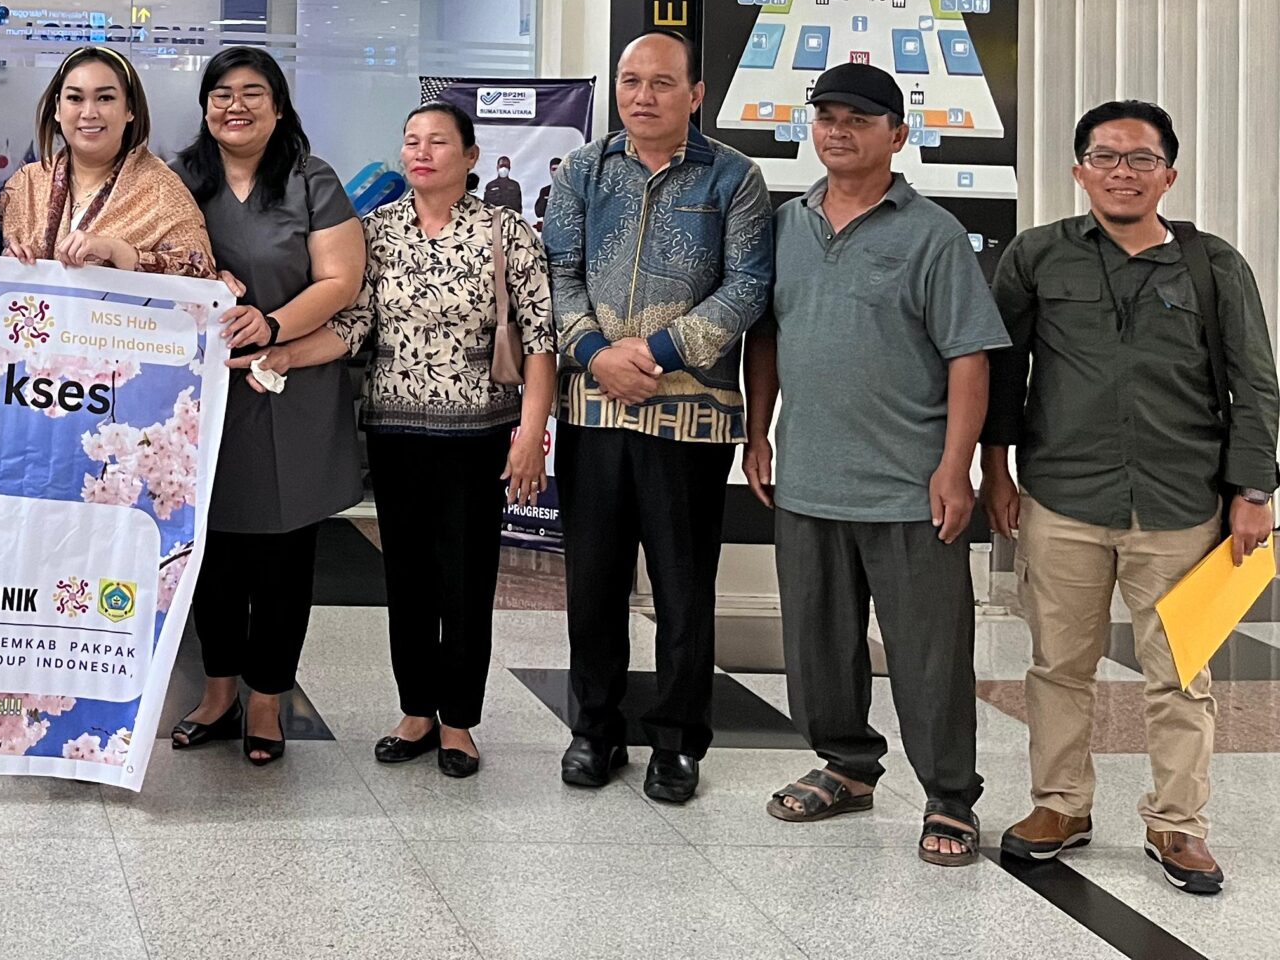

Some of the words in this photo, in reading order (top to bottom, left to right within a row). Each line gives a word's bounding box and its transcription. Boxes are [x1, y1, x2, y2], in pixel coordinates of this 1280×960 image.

[91, 311, 121, 327] MSS
[127, 316, 157, 331] Hub
[61, 331, 108, 348] Group
[112, 336, 185, 356] Indonesia
[507, 504, 559, 520] PROGRESIF
[70, 642, 136, 658] PAKPAK
[36, 657, 134, 678] INDONESIA,
